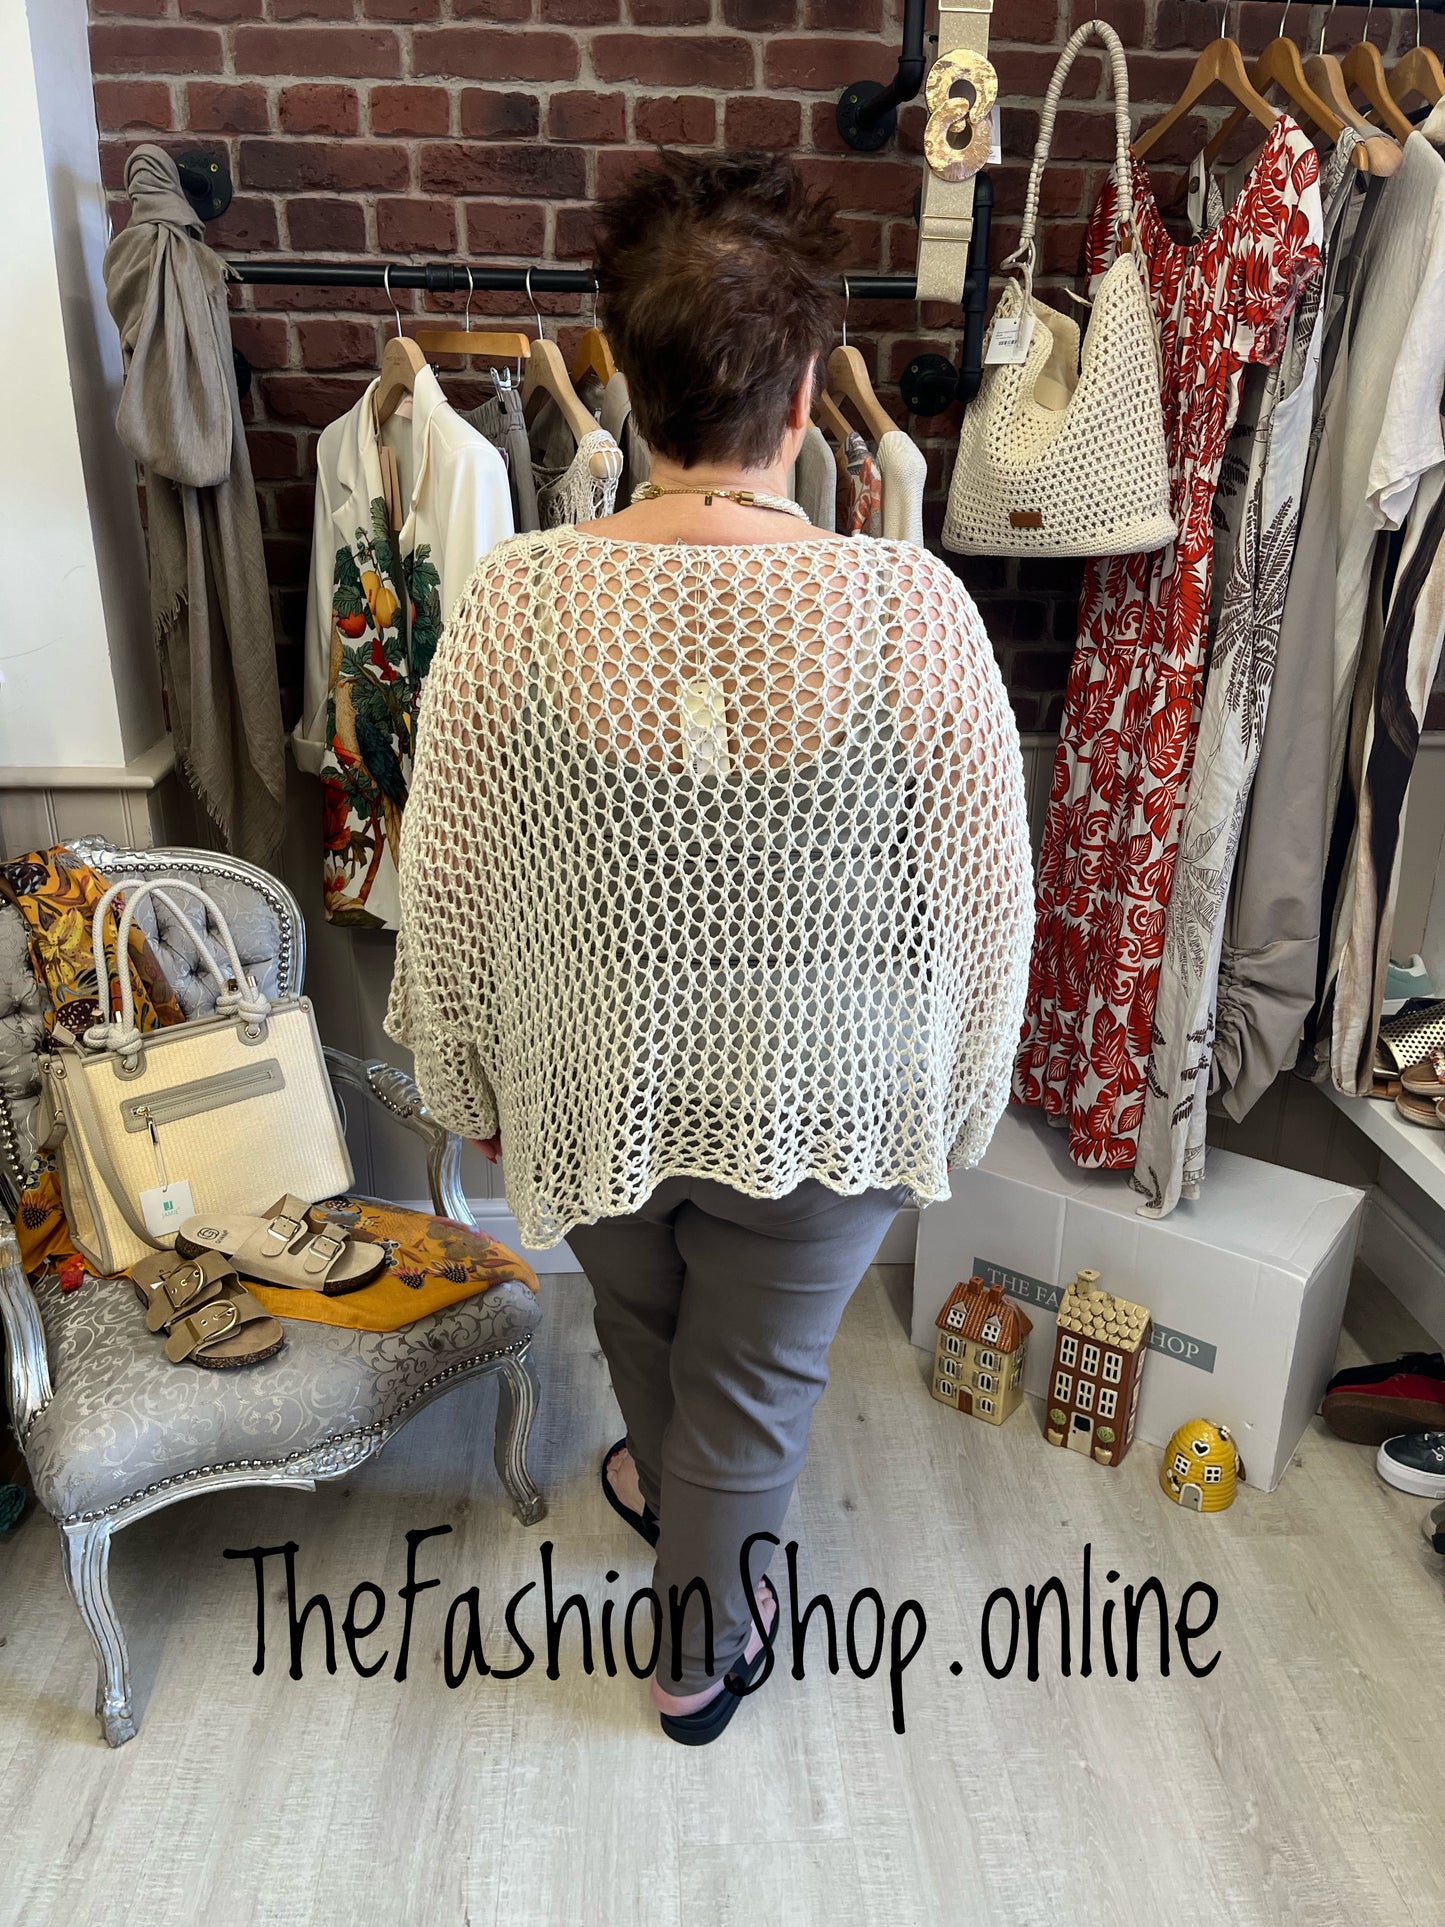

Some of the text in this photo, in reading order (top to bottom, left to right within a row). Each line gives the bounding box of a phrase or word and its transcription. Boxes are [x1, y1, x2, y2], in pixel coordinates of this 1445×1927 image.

[987, 1267, 1200, 1359] THE FA HOP
